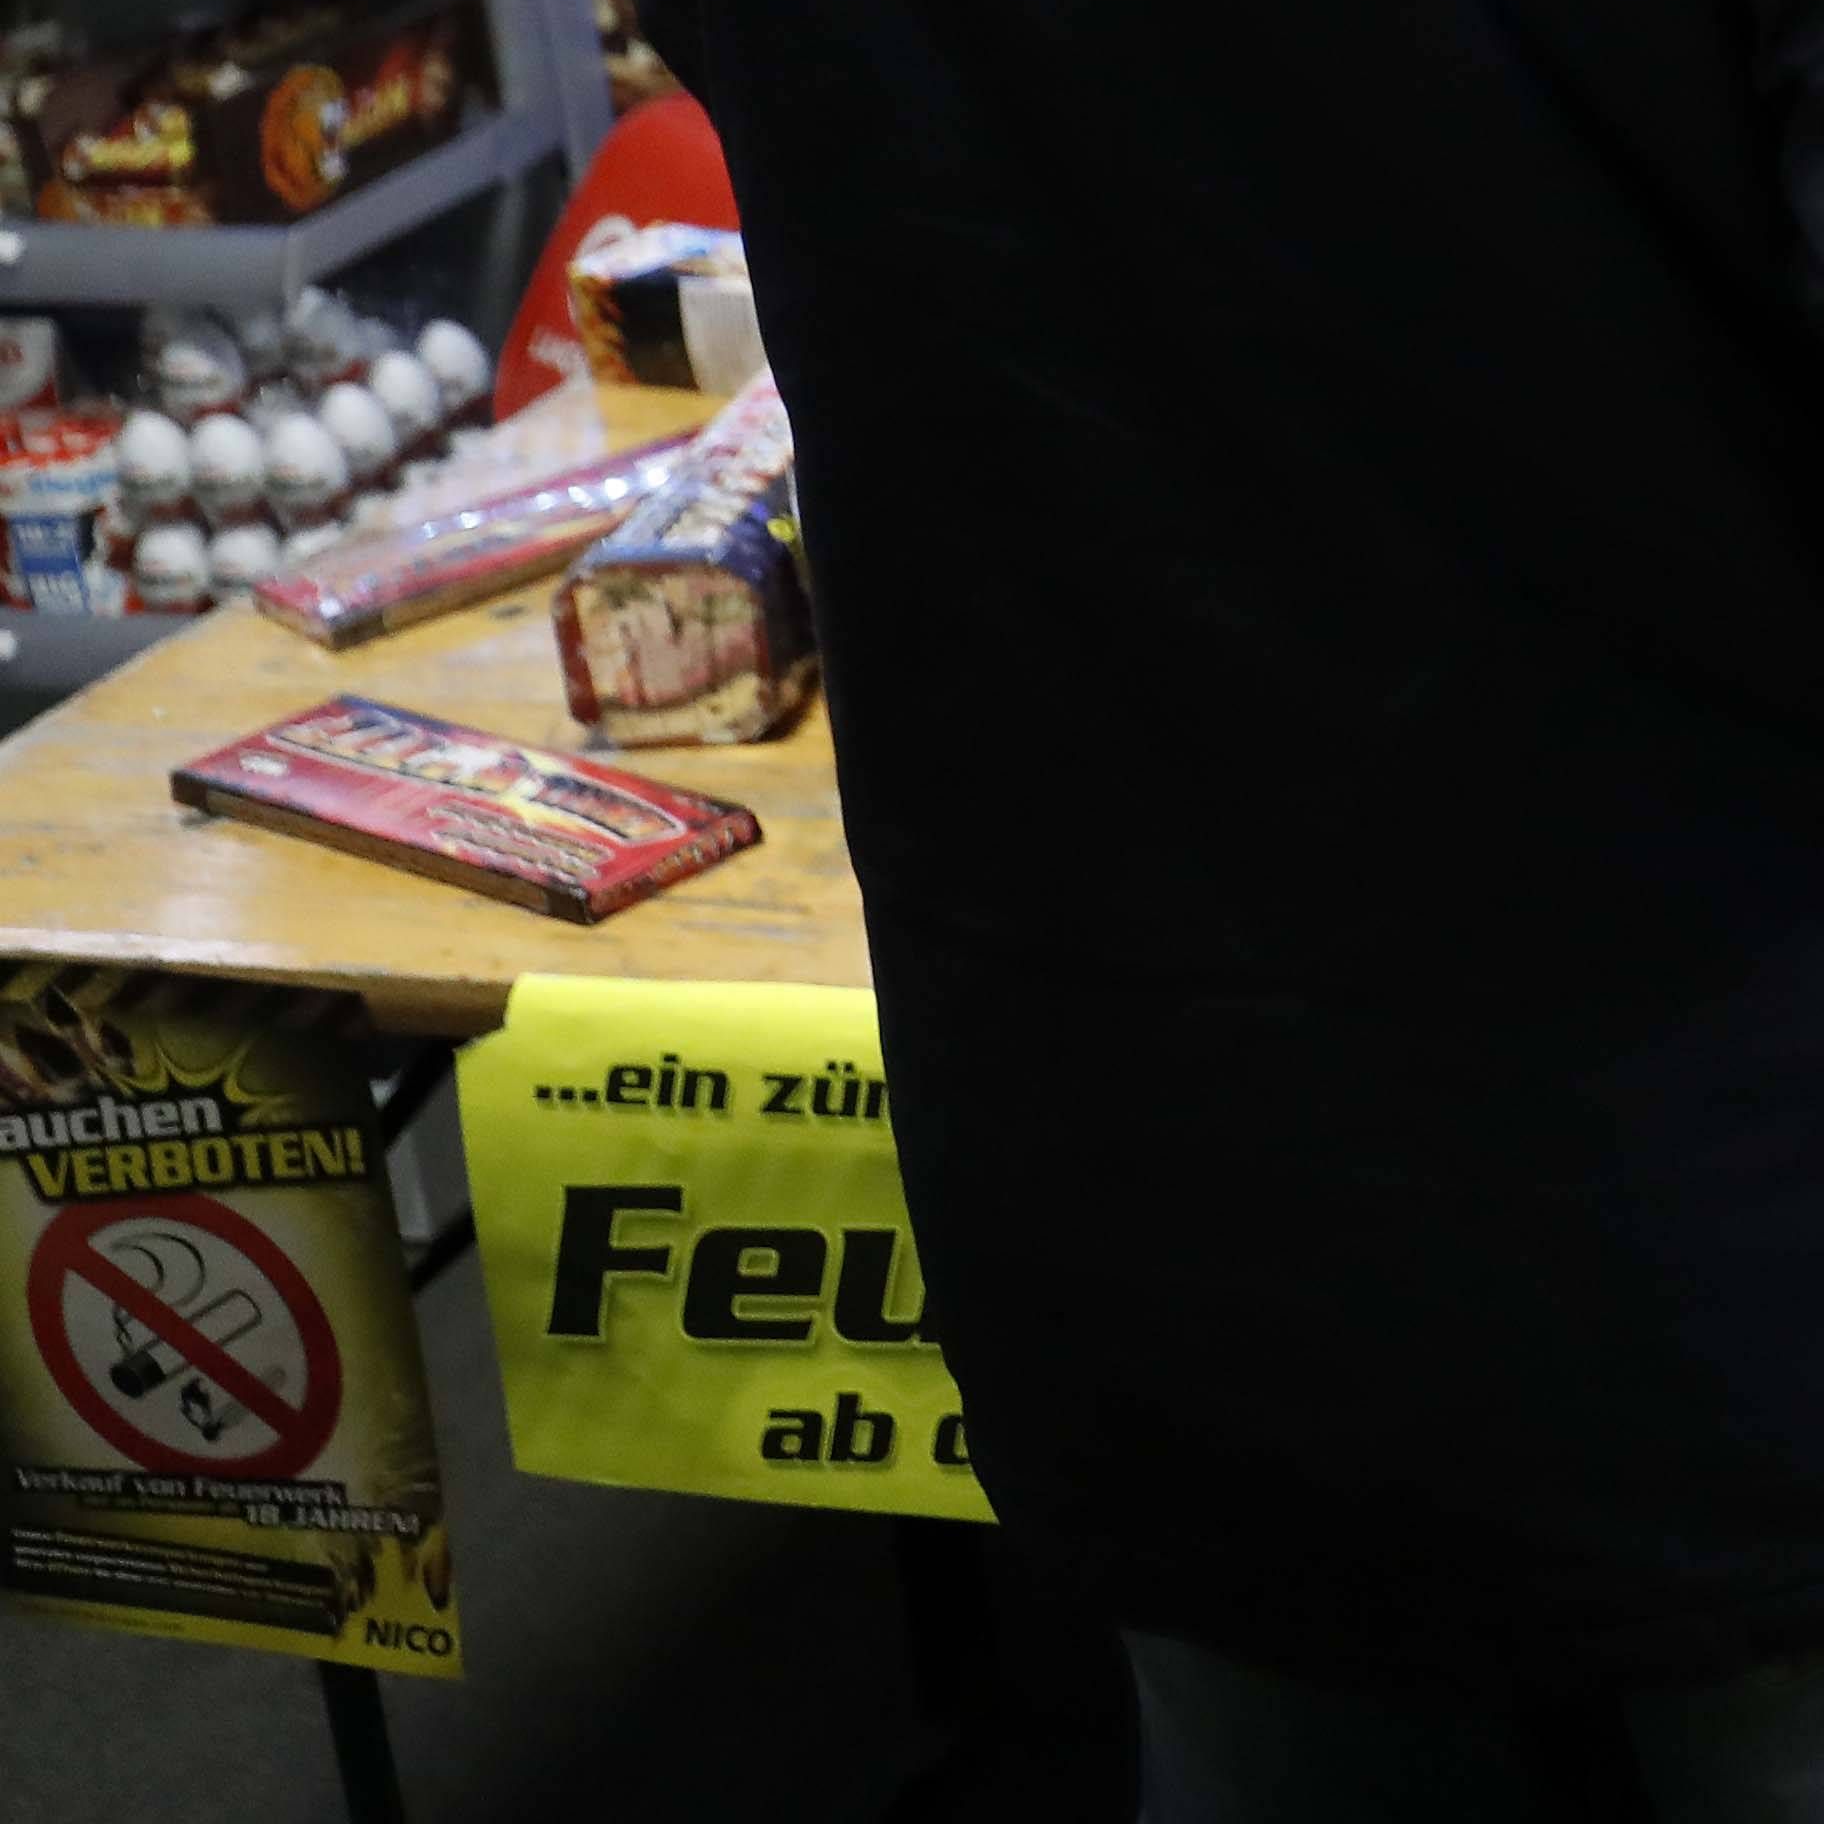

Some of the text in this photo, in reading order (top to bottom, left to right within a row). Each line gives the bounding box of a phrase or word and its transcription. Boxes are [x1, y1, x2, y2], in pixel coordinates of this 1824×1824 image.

[0, 1096, 223, 1152] auchen
[28, 1128, 367, 1199] VERBOTEN!
[546, 1184, 926, 1343] Feu
[760, 1392, 896, 1464] ab
[364, 1617, 455, 1656] NICO
